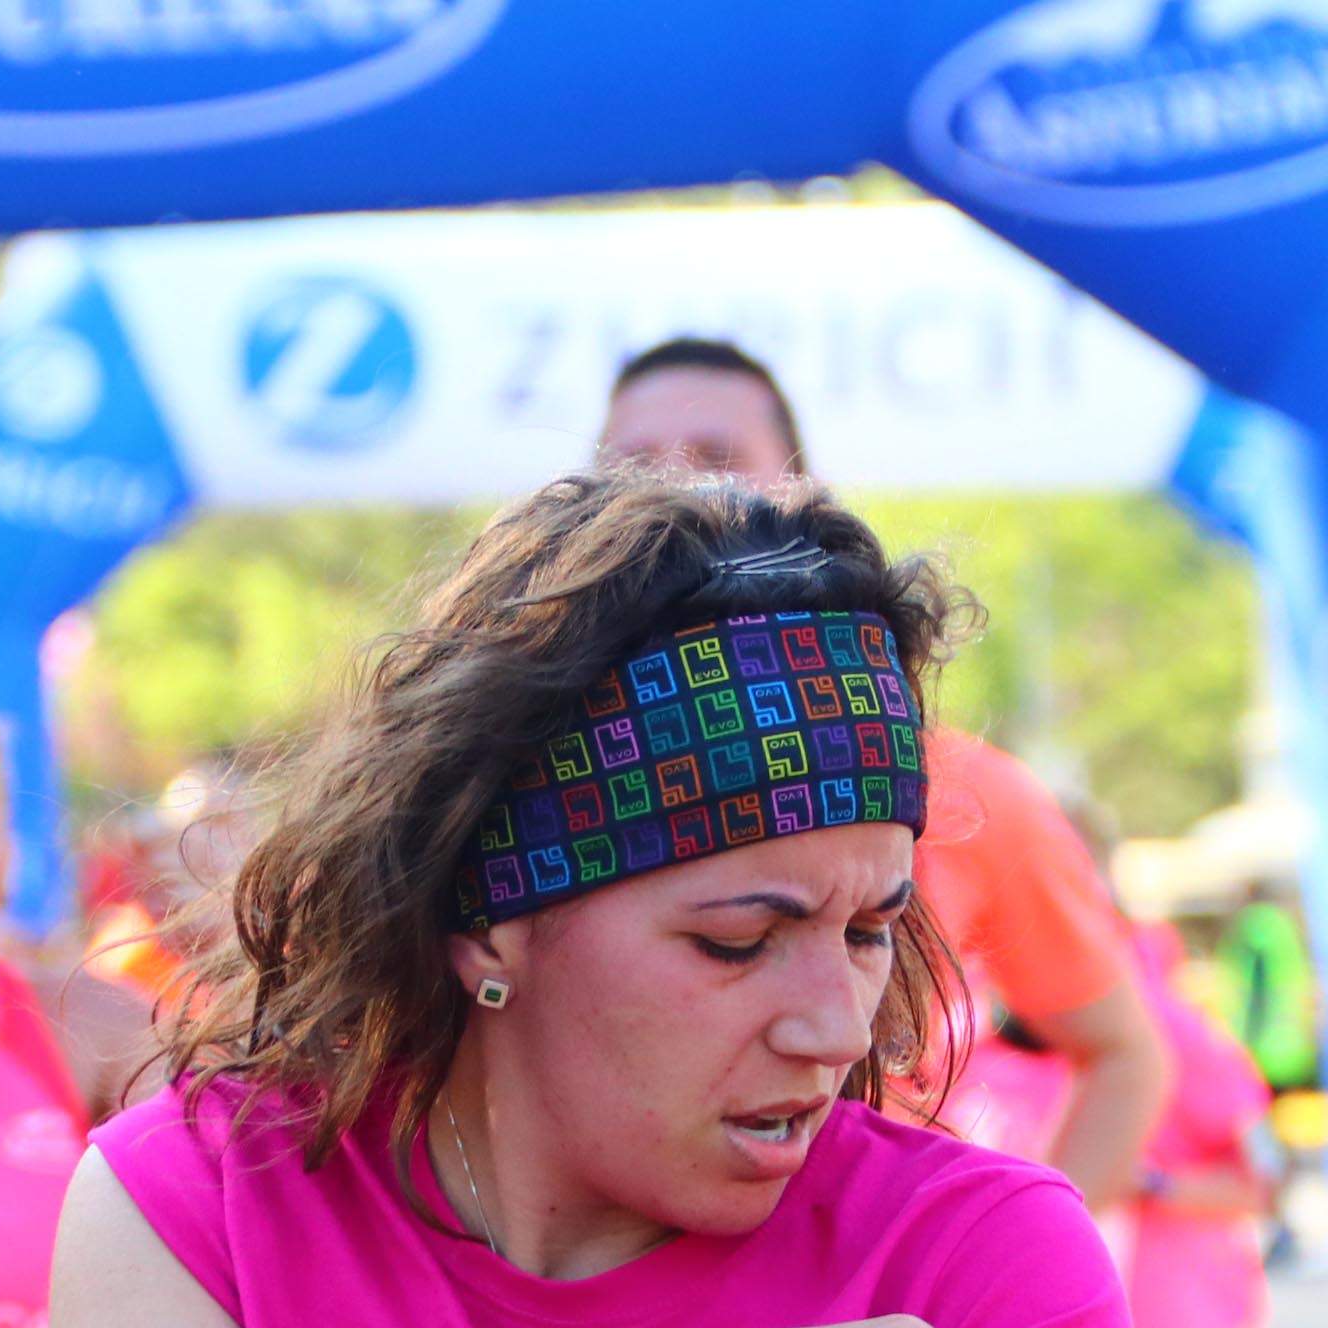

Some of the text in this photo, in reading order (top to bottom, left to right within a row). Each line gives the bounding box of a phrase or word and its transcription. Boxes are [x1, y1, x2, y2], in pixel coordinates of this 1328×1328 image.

[480, 290, 1080, 412] ZICH
[694, 669, 721, 681] EVO
[848, 678, 868, 686] EVO
[755, 687, 781, 697] EVO
[813, 704, 835, 713] EVO
[709, 720, 736, 732] EVO
[770, 739, 795, 749] EVO
[778, 791, 802, 802] EVO
[830, 809, 851, 818] EVO
